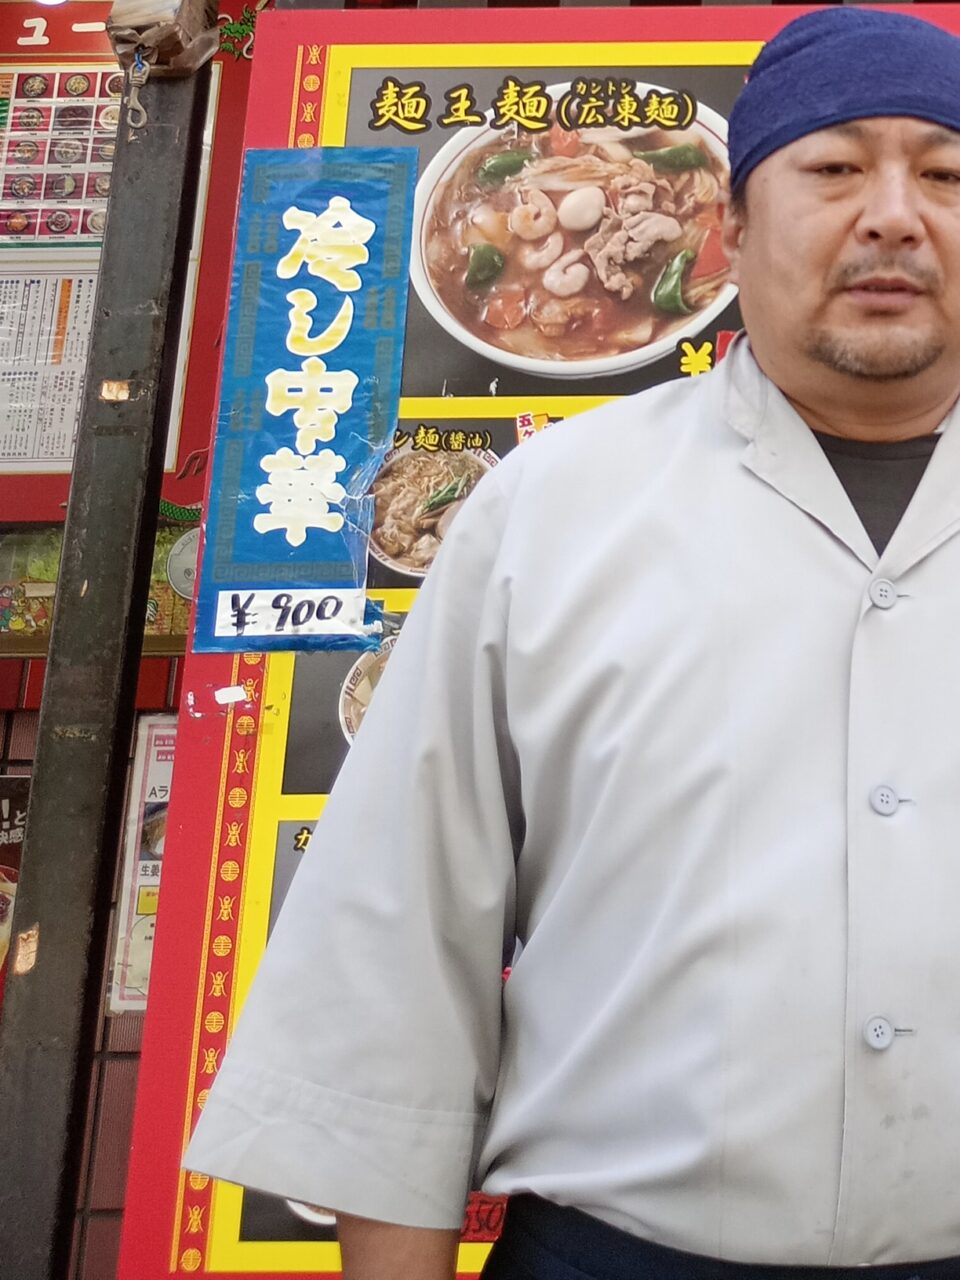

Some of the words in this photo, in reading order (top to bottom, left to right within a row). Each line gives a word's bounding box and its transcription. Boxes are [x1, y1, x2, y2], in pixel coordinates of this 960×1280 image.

[576, 82, 632, 94] カントン
[253, 195, 376, 547] 冷し中華
